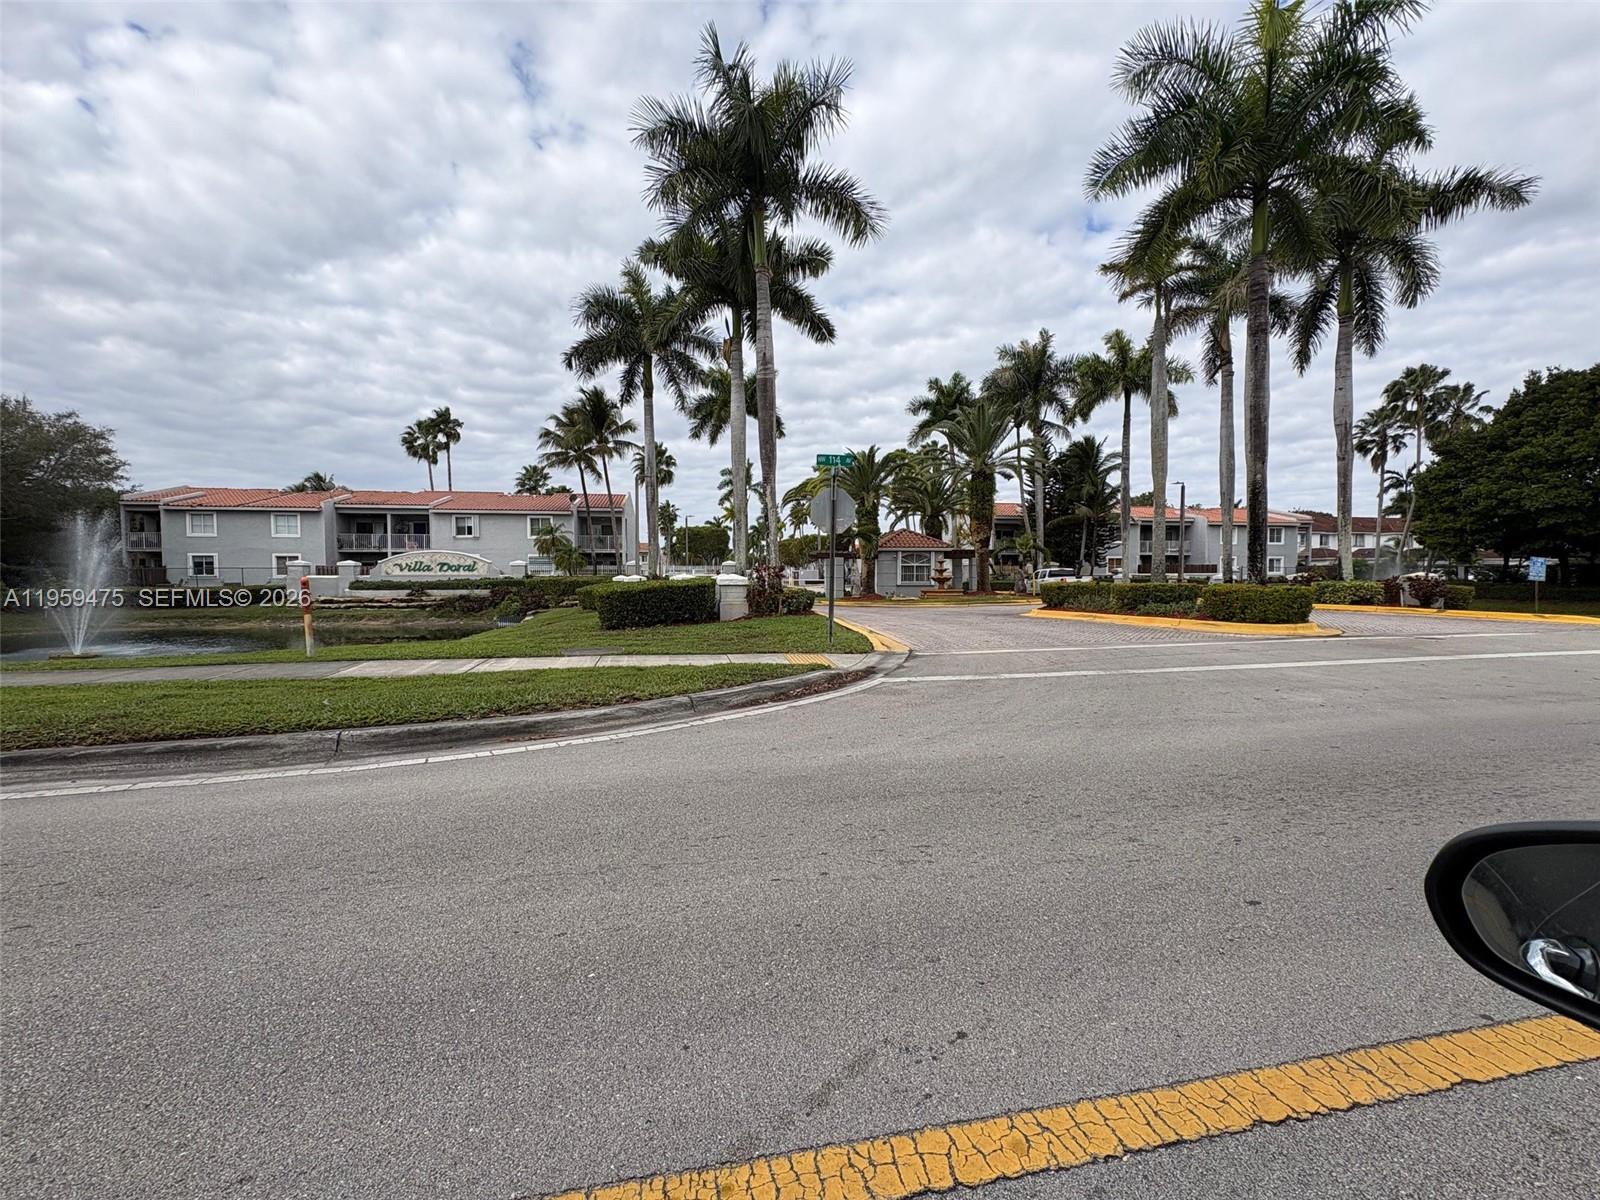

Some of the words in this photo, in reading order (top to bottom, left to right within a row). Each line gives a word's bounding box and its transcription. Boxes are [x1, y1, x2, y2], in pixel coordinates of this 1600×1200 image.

[829, 455, 841, 465] 114
[393, 561, 433, 572] Villa
[437, 561, 477, 572] Doral
